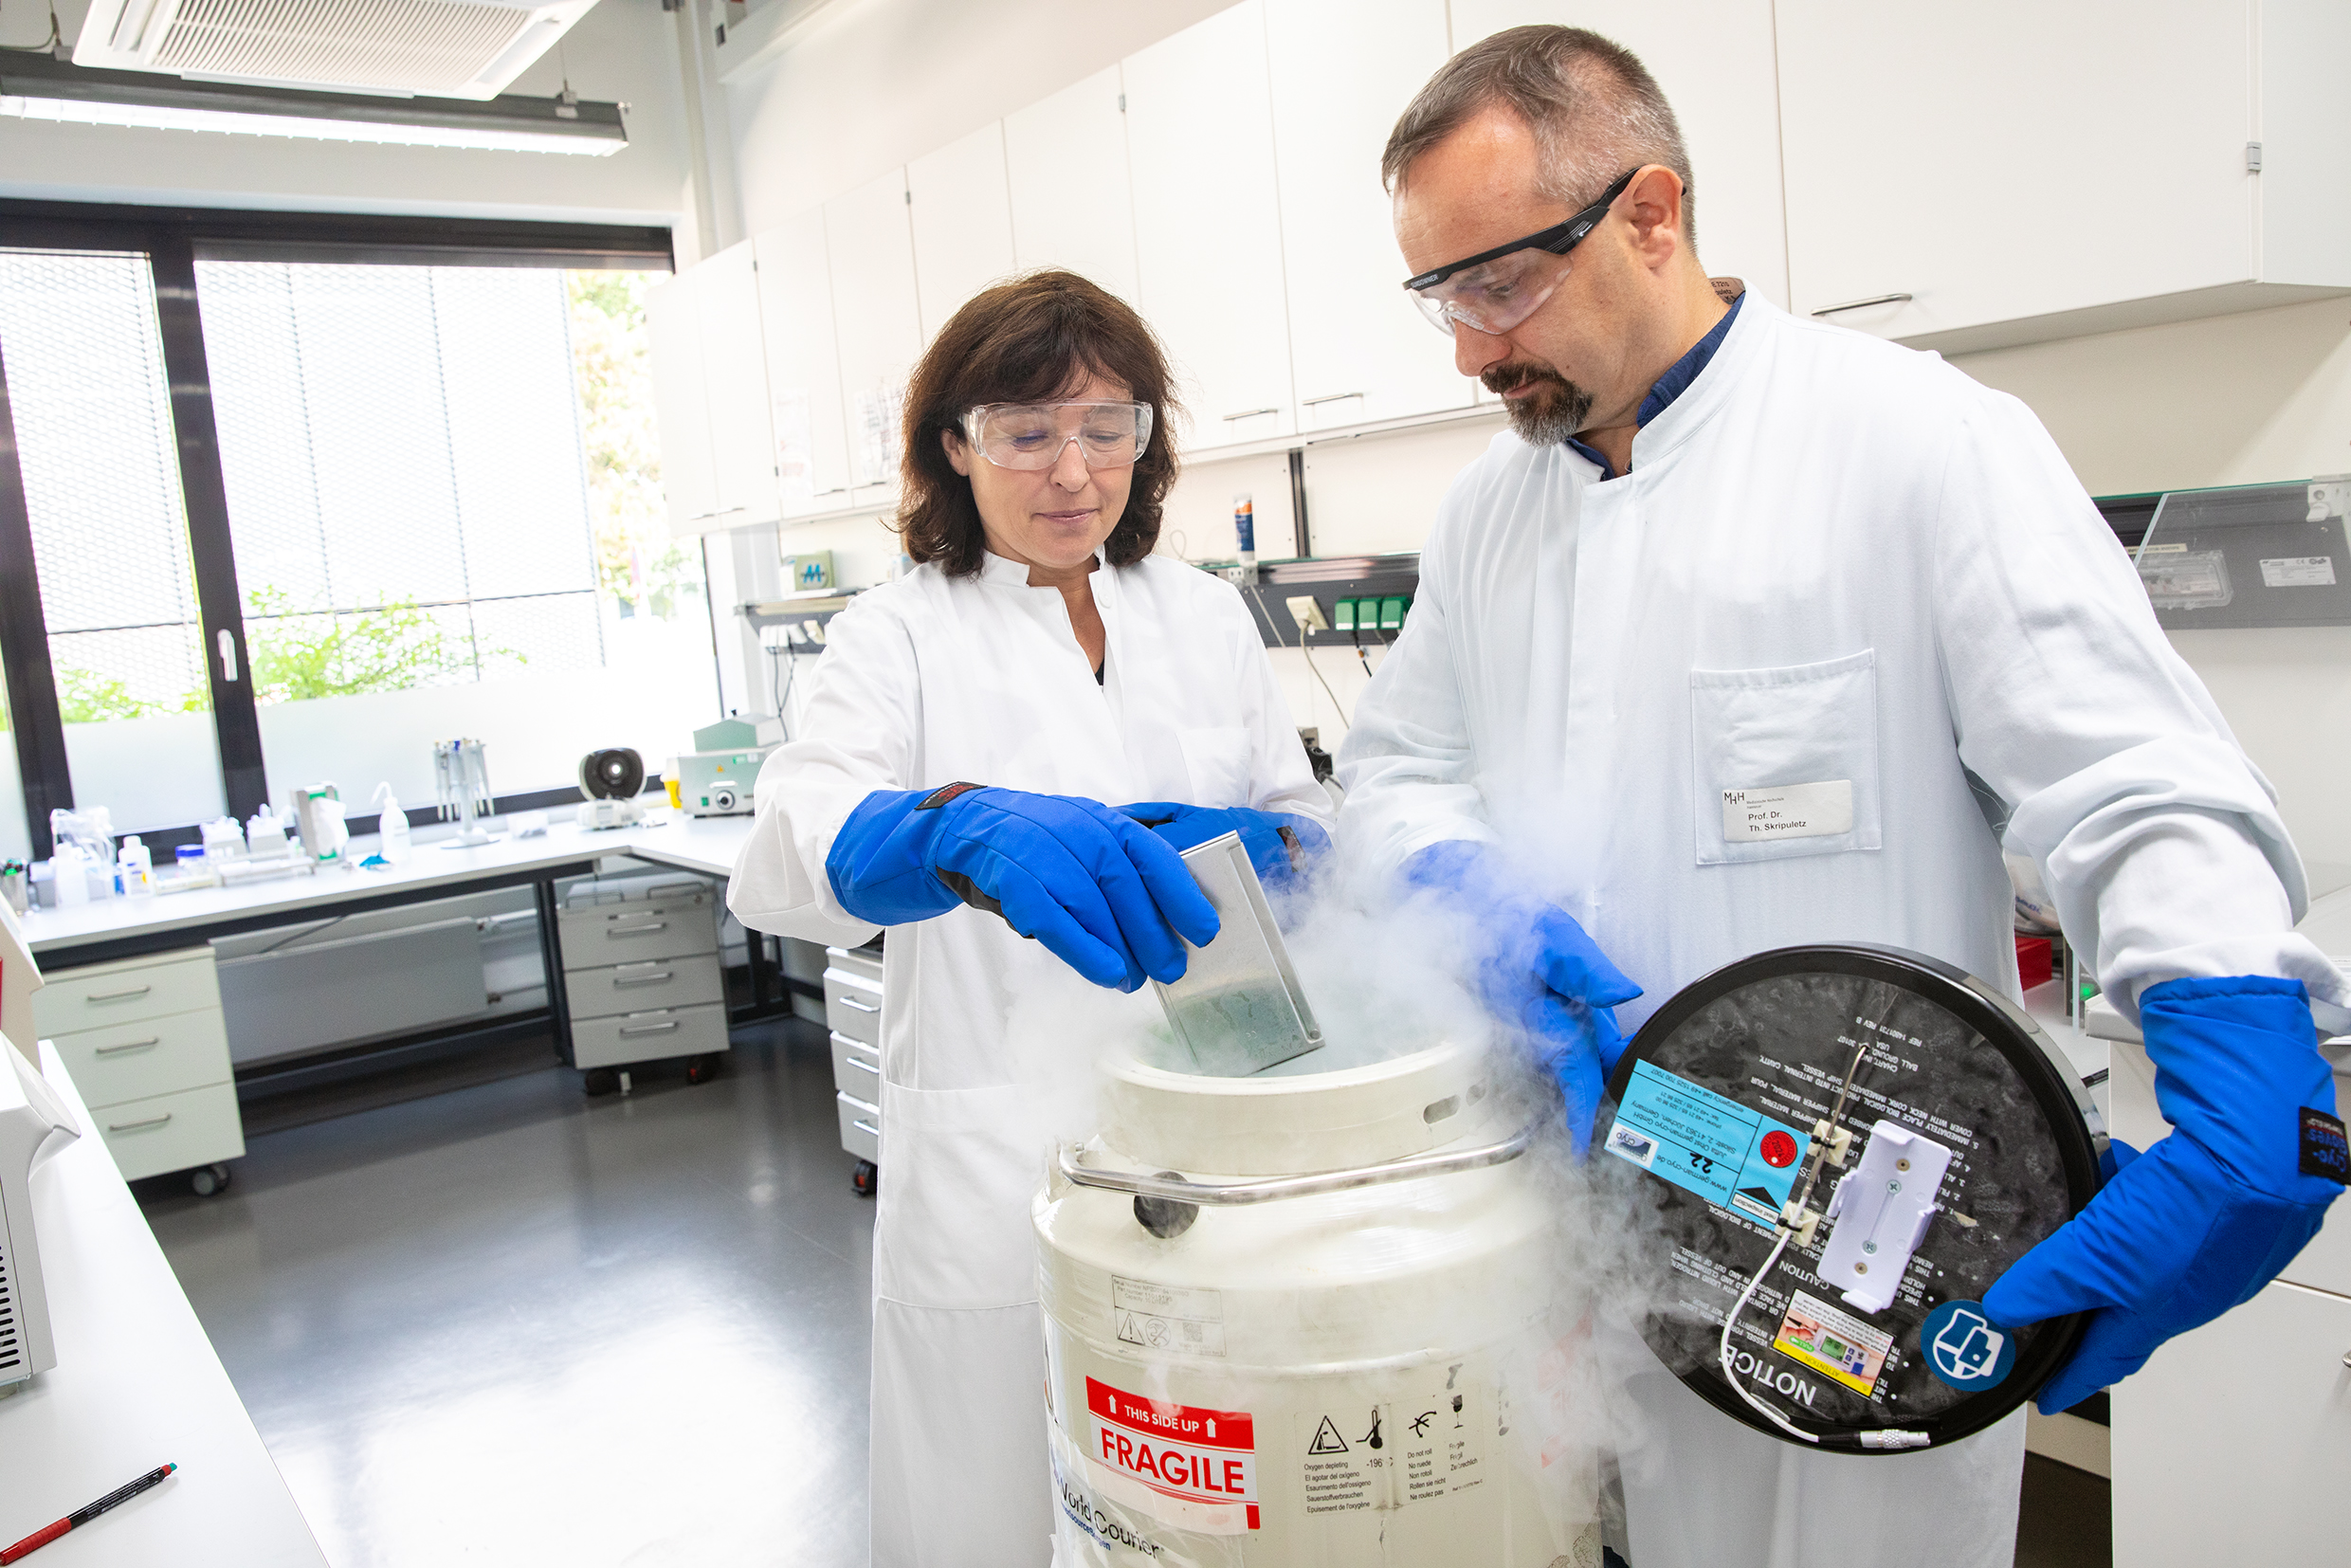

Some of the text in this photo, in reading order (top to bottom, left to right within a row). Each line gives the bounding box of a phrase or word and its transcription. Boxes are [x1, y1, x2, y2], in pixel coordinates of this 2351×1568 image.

[1723, 793, 1744, 805] MHH
[1764, 821, 1806, 830] Skripuletz
[1863, 1018, 1877, 1029] REV
[1878, 1024, 1907, 1041] 14801731
[1836, 1033, 1856, 1047] 30107
[1874, 1040, 1890, 1051] USA
[1907, 1035, 1923, 1047] REF
[1871, 1057, 1899, 1073] CHART,
[1899, 1058, 1919, 1071] BALL
[1649, 1067, 1665, 1078] 7007
[1664, 1074, 1676, 1083] 700
[1781, 1064, 1813, 1082] INTERNAL
[1826, 1073, 1843, 1085] SHIP
[1675, 1079, 1690, 1089] 1525
[1749, 1075, 1768, 1088] POUR
[1813, 1077, 1831, 1088] INTO
[1830, 1084, 1861, 1101] PROUCT
[1630, 1100, 1660, 1119] Germany
[1713, 1095, 1744, 1113] emergency
[1757, 1094, 1790, 1113] MATERIAL.
[1801, 1097, 1830, 1114] SHIPPER
[1861, 1096, 1900, 1117] BIOLOGICAL
[1631, 1110, 1654, 1125] GmbH
[1790, 1108, 1817, 1124] SHIPPER
[1901, 1112, 1924, 1126] PLACE
[1908, 1106, 1928, 1119] NECK
[1929, 1115, 1948, 1127] WITH
[1614, 1129, 1636, 1145] cryo
[1653, 1119, 1694, 1143] german-cryo
[1685, 1125, 1705, 1140] 41363
[1924, 1121, 1970, 1145] IMMEDIATELY
[1948, 1122, 1973, 1138] COVER
[1693, 1139, 1710, 1151] Ohst
[1709, 1146, 1727, 1159] Jutta
[1685, 1150, 1714, 1175] 22
[1655, 1154, 1728, 1193] www.german-cryo.de
[1734, 1195, 1763, 1213] inspection
[1705, 1204, 1741, 1225] BIOLOGICAL
[1763, 1211, 1777, 1219] next
[1741, 1220, 1752, 1230] OF
[1753, 1226, 1780, 1243] HIPMENT
[1670, 1250, 1689, 1264] WHEN
[1703, 1256, 1713, 1266] OF
[1689, 1259, 1719, 1278] CLOTHING
[1714, 1262, 1727, 1272] OUT
[1727, 1268, 1742, 1280] AND
[1914, 1265, 1931, 1277] THIS
[1701, 1273, 1722, 1287] LIQUID
[1719, 1273, 1734, 1285] AND
[1777, 1259, 1831, 1290] CAUTION
[1722, 1284, 1739, 1296] WITH
[1755, 1281, 1783, 1299] NITROGE
[1758, 1291, 1775, 1304] FACE
[1903, 1293, 1920, 1305] THIS
[1677, 1299, 1698, 1313] LIQUID
[1709, 1304, 1723, 1317] NOT
[1767, 1304, 1779, 1315] OR
[1697, 1307, 1715, 1321] WITH
[1744, 1331, 1769, 1347] VESSEL
[1804, 1355, 1839, 1377] ATTENTION
[1884, 1360, 1895, 1370] TO
[1717, 1341, 1816, 1405] NOTICE
[1124, 1405, 1199, 1432] THIS SIDE UP
[1101, 1427, 1245, 1494] FRAGILE
[1303, 1463, 1323, 1471] Oxygen
[1367, 1458, 1382, 1468] -196
[1339, 1480, 1371, 1489] dell'ossigeno
[1306, 1492, 1363, 1502] Sauerstoffverbrauchen
[1307, 1504, 1338, 1513] Epuisement
[1094, 1510, 1158, 1559] Courier
